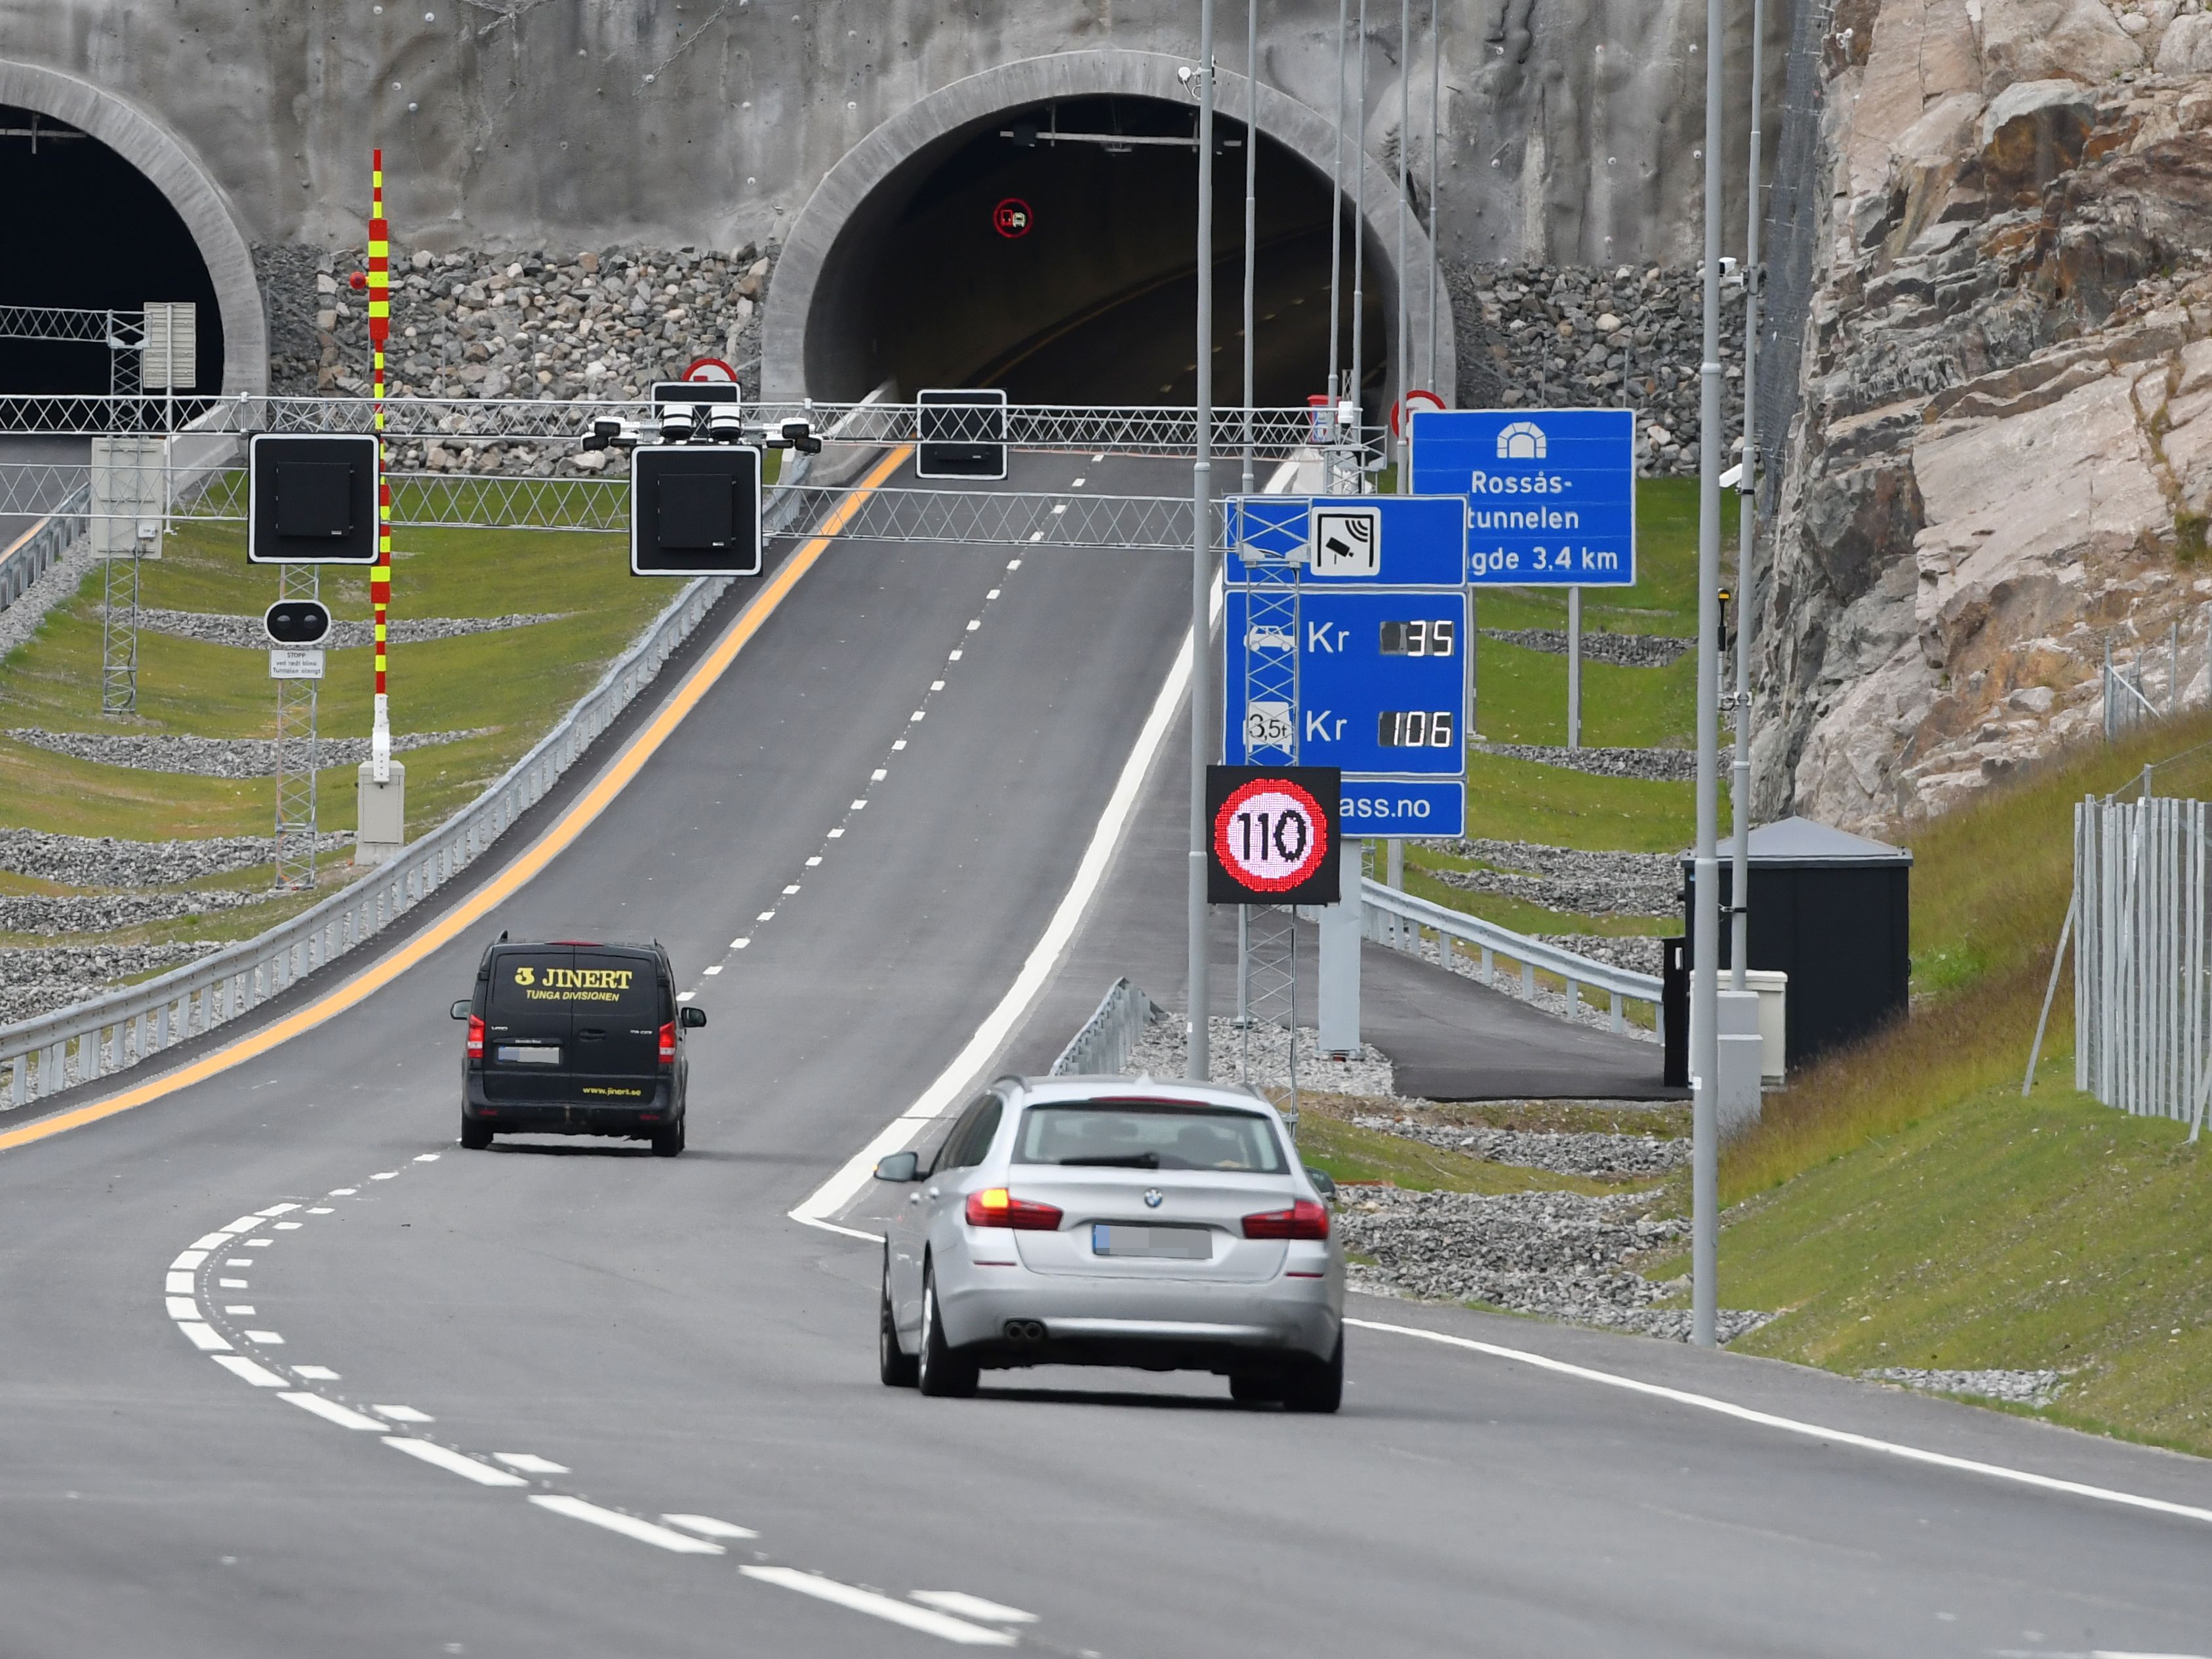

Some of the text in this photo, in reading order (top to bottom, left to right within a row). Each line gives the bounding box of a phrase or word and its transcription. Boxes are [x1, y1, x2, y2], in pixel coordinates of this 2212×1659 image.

[1472, 470, 1573, 494] Rossås-
[1468, 506, 1579, 529] tunnelen
[1467, 546, 1619, 576] gde 3,4 km
[1308, 620, 1453, 656] Kr 35
[1306, 710, 1451, 748] Kr 106
[1339, 797, 1430, 818] ass.no
[1237, 809, 1306, 862] 110
[542, 968, 633, 989] JINERT
[526, 989, 620, 1002] TUNGA DIVISIONEN
[582, 1087, 641, 1096] www.jinert.se
